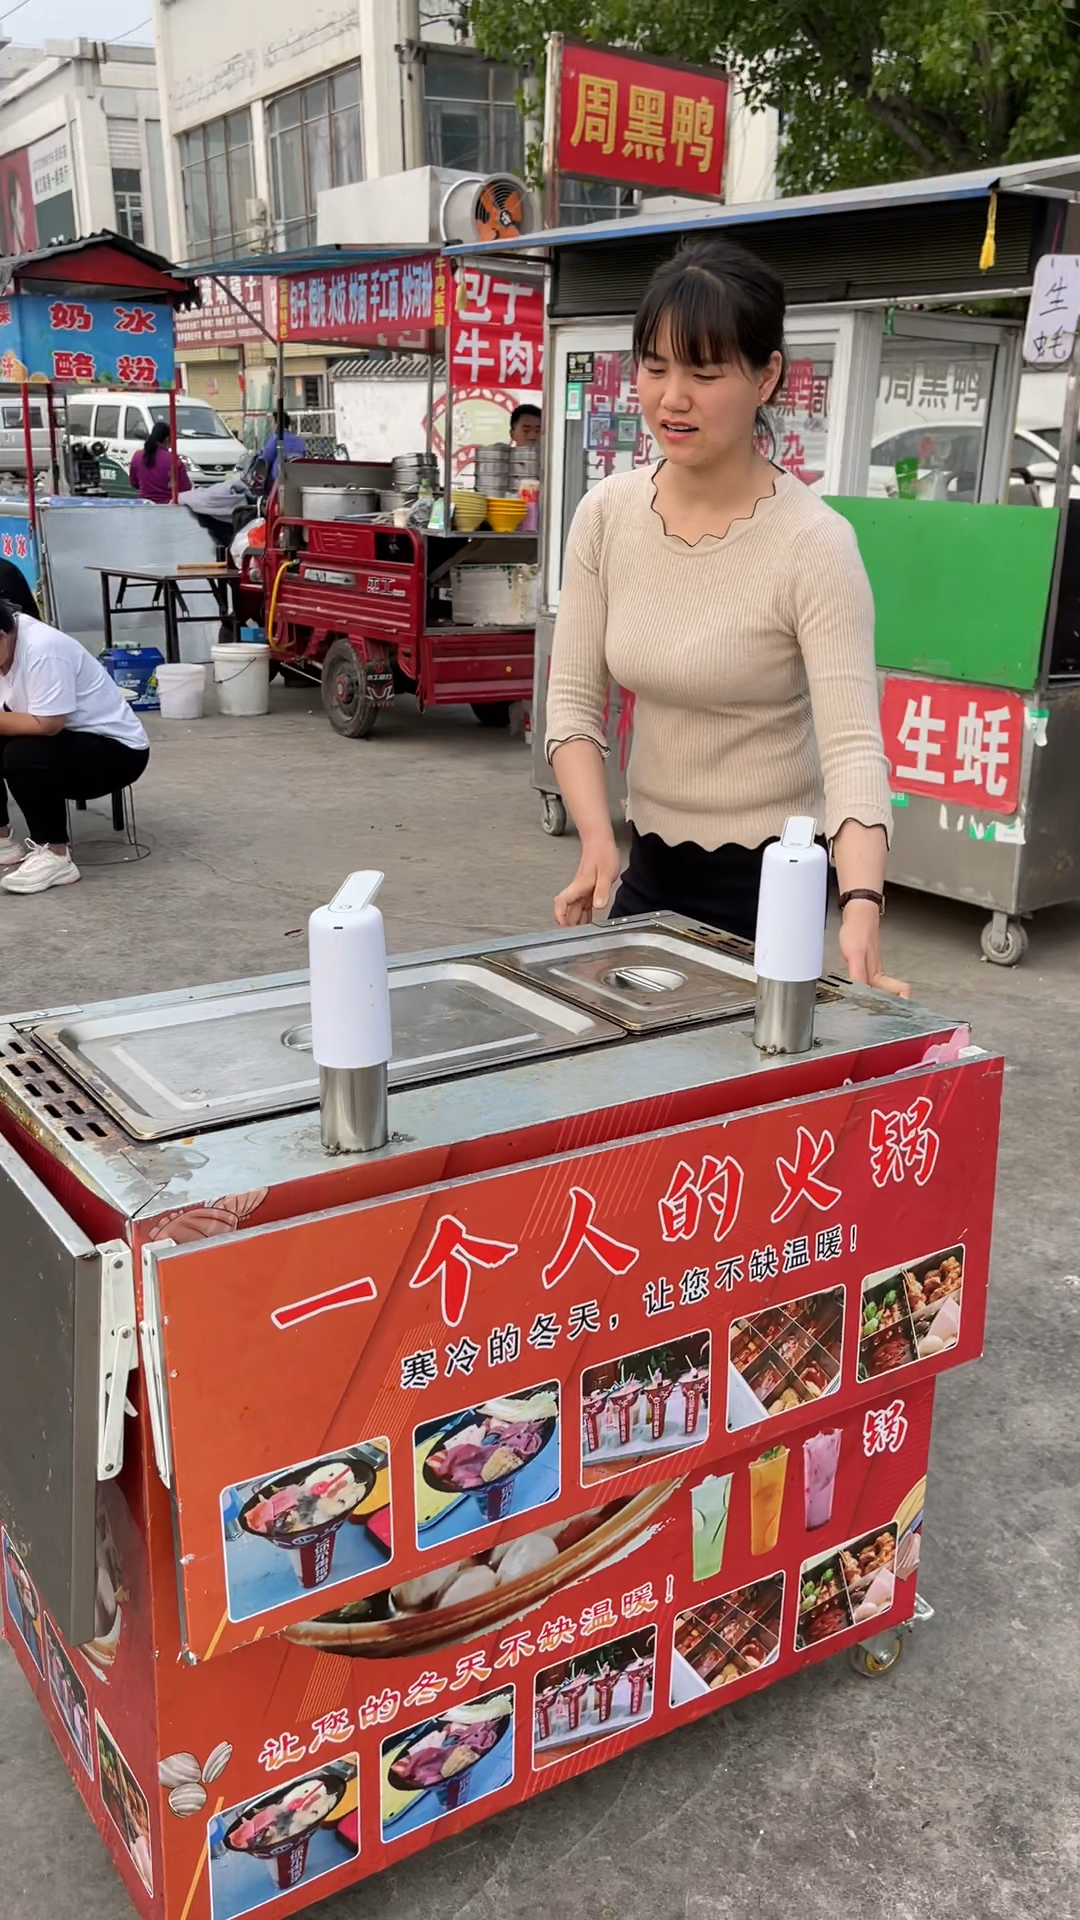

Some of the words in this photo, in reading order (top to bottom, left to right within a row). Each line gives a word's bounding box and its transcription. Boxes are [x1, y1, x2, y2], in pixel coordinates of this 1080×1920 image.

[570, 73, 715, 173] 周黑鸭
[289, 281, 307, 329] 包子
[328, 274, 346, 327] 水饺
[348, 271, 368, 324] 炒面
[370, 268, 399, 323] 手工面
[401, 261, 433, 320] 炒河粉
[1032, 276, 1069, 360] 生蚝
[49, 301, 96, 378] 奶酪
[113, 306, 158, 383] 冰粉
[452, 328, 544, 385] 牛肉
[884, 360, 981, 413] 周黑鸭
[896, 695, 1011, 796] 生蚝
[270, 1096, 940, 1328] 一个人的火锅
[863, 1398, 908, 1457] 锅
[258, 1574, 675, 1772] 让您的冬天不缺温暖！
